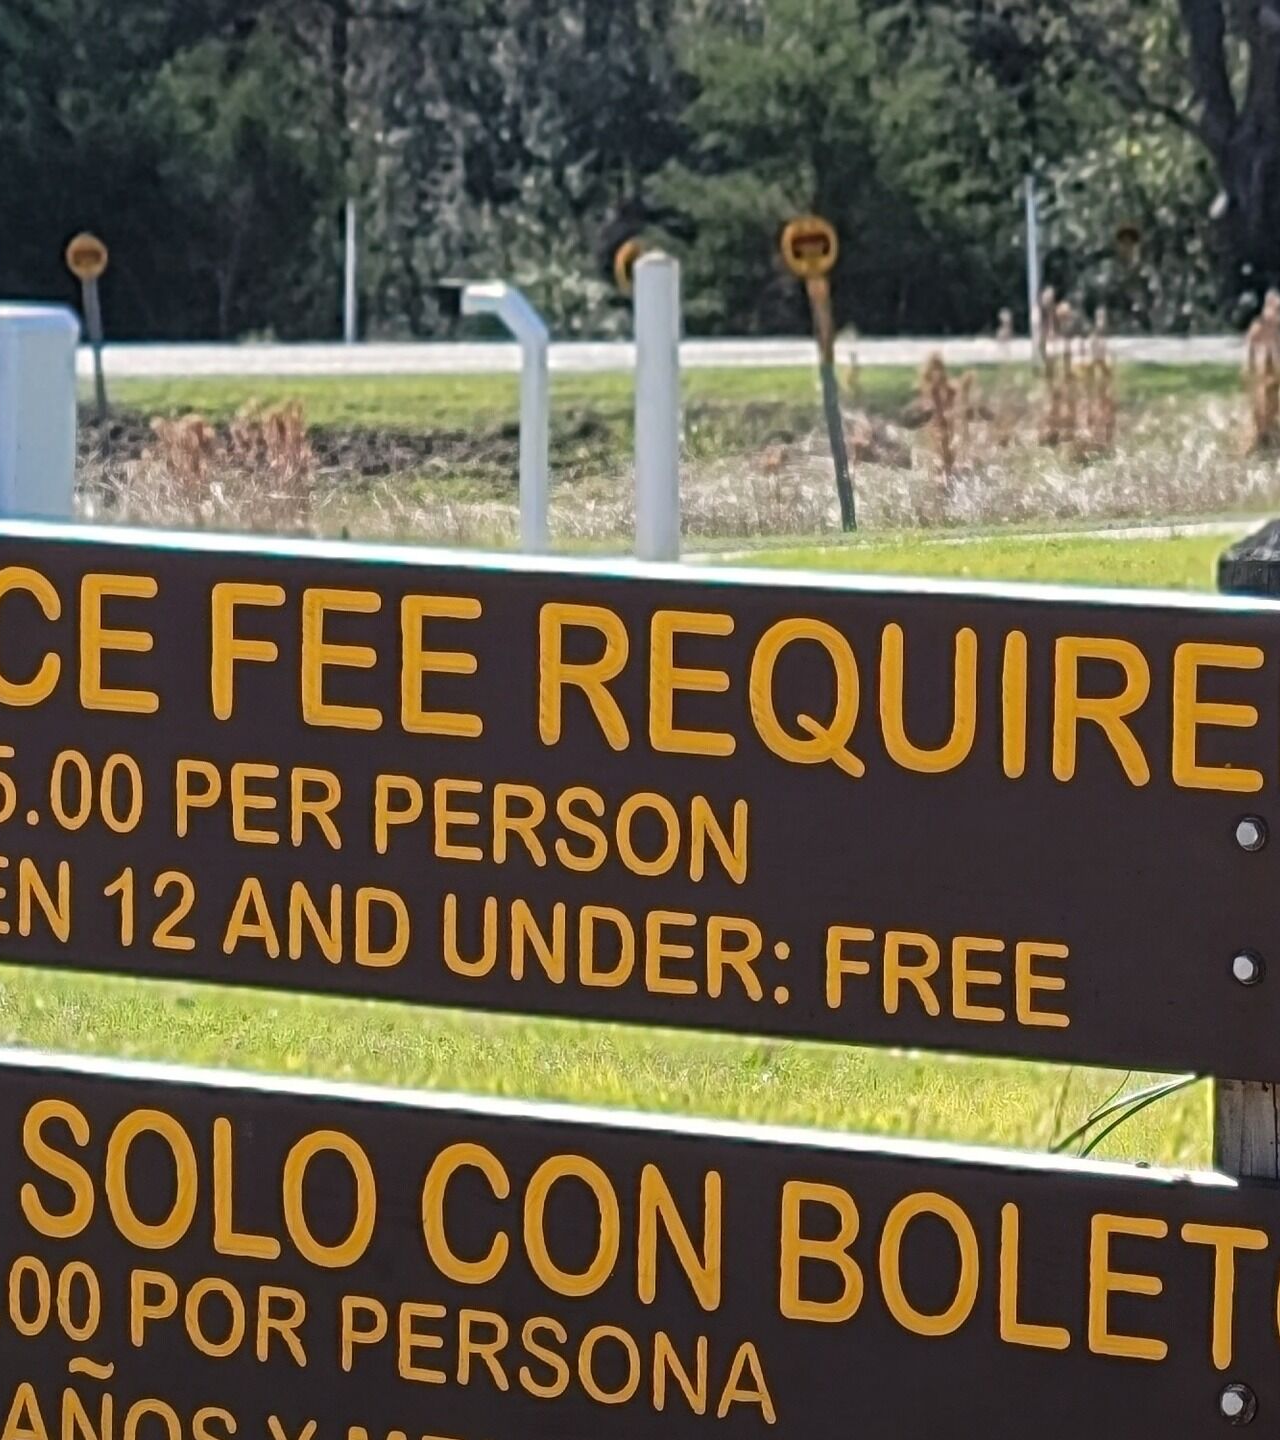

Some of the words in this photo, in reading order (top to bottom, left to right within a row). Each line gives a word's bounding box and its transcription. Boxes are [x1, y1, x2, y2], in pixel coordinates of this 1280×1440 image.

[211, 583, 482, 738] FEE
[176, 759, 341, 850] PER
[375, 775, 748, 884] PERSON
[106, 869, 195, 951] 12
[223, 878, 410, 968] AND
[444, 895, 791, 1005] UNDER:
[826, 926, 1067, 1028] FREE
[21, 1100, 376, 1268] SOLO
[422, 1143, 721, 1310] CON
[131, 1269, 305, 1364] POR
[342, 1296, 775, 1421] PERSONA
